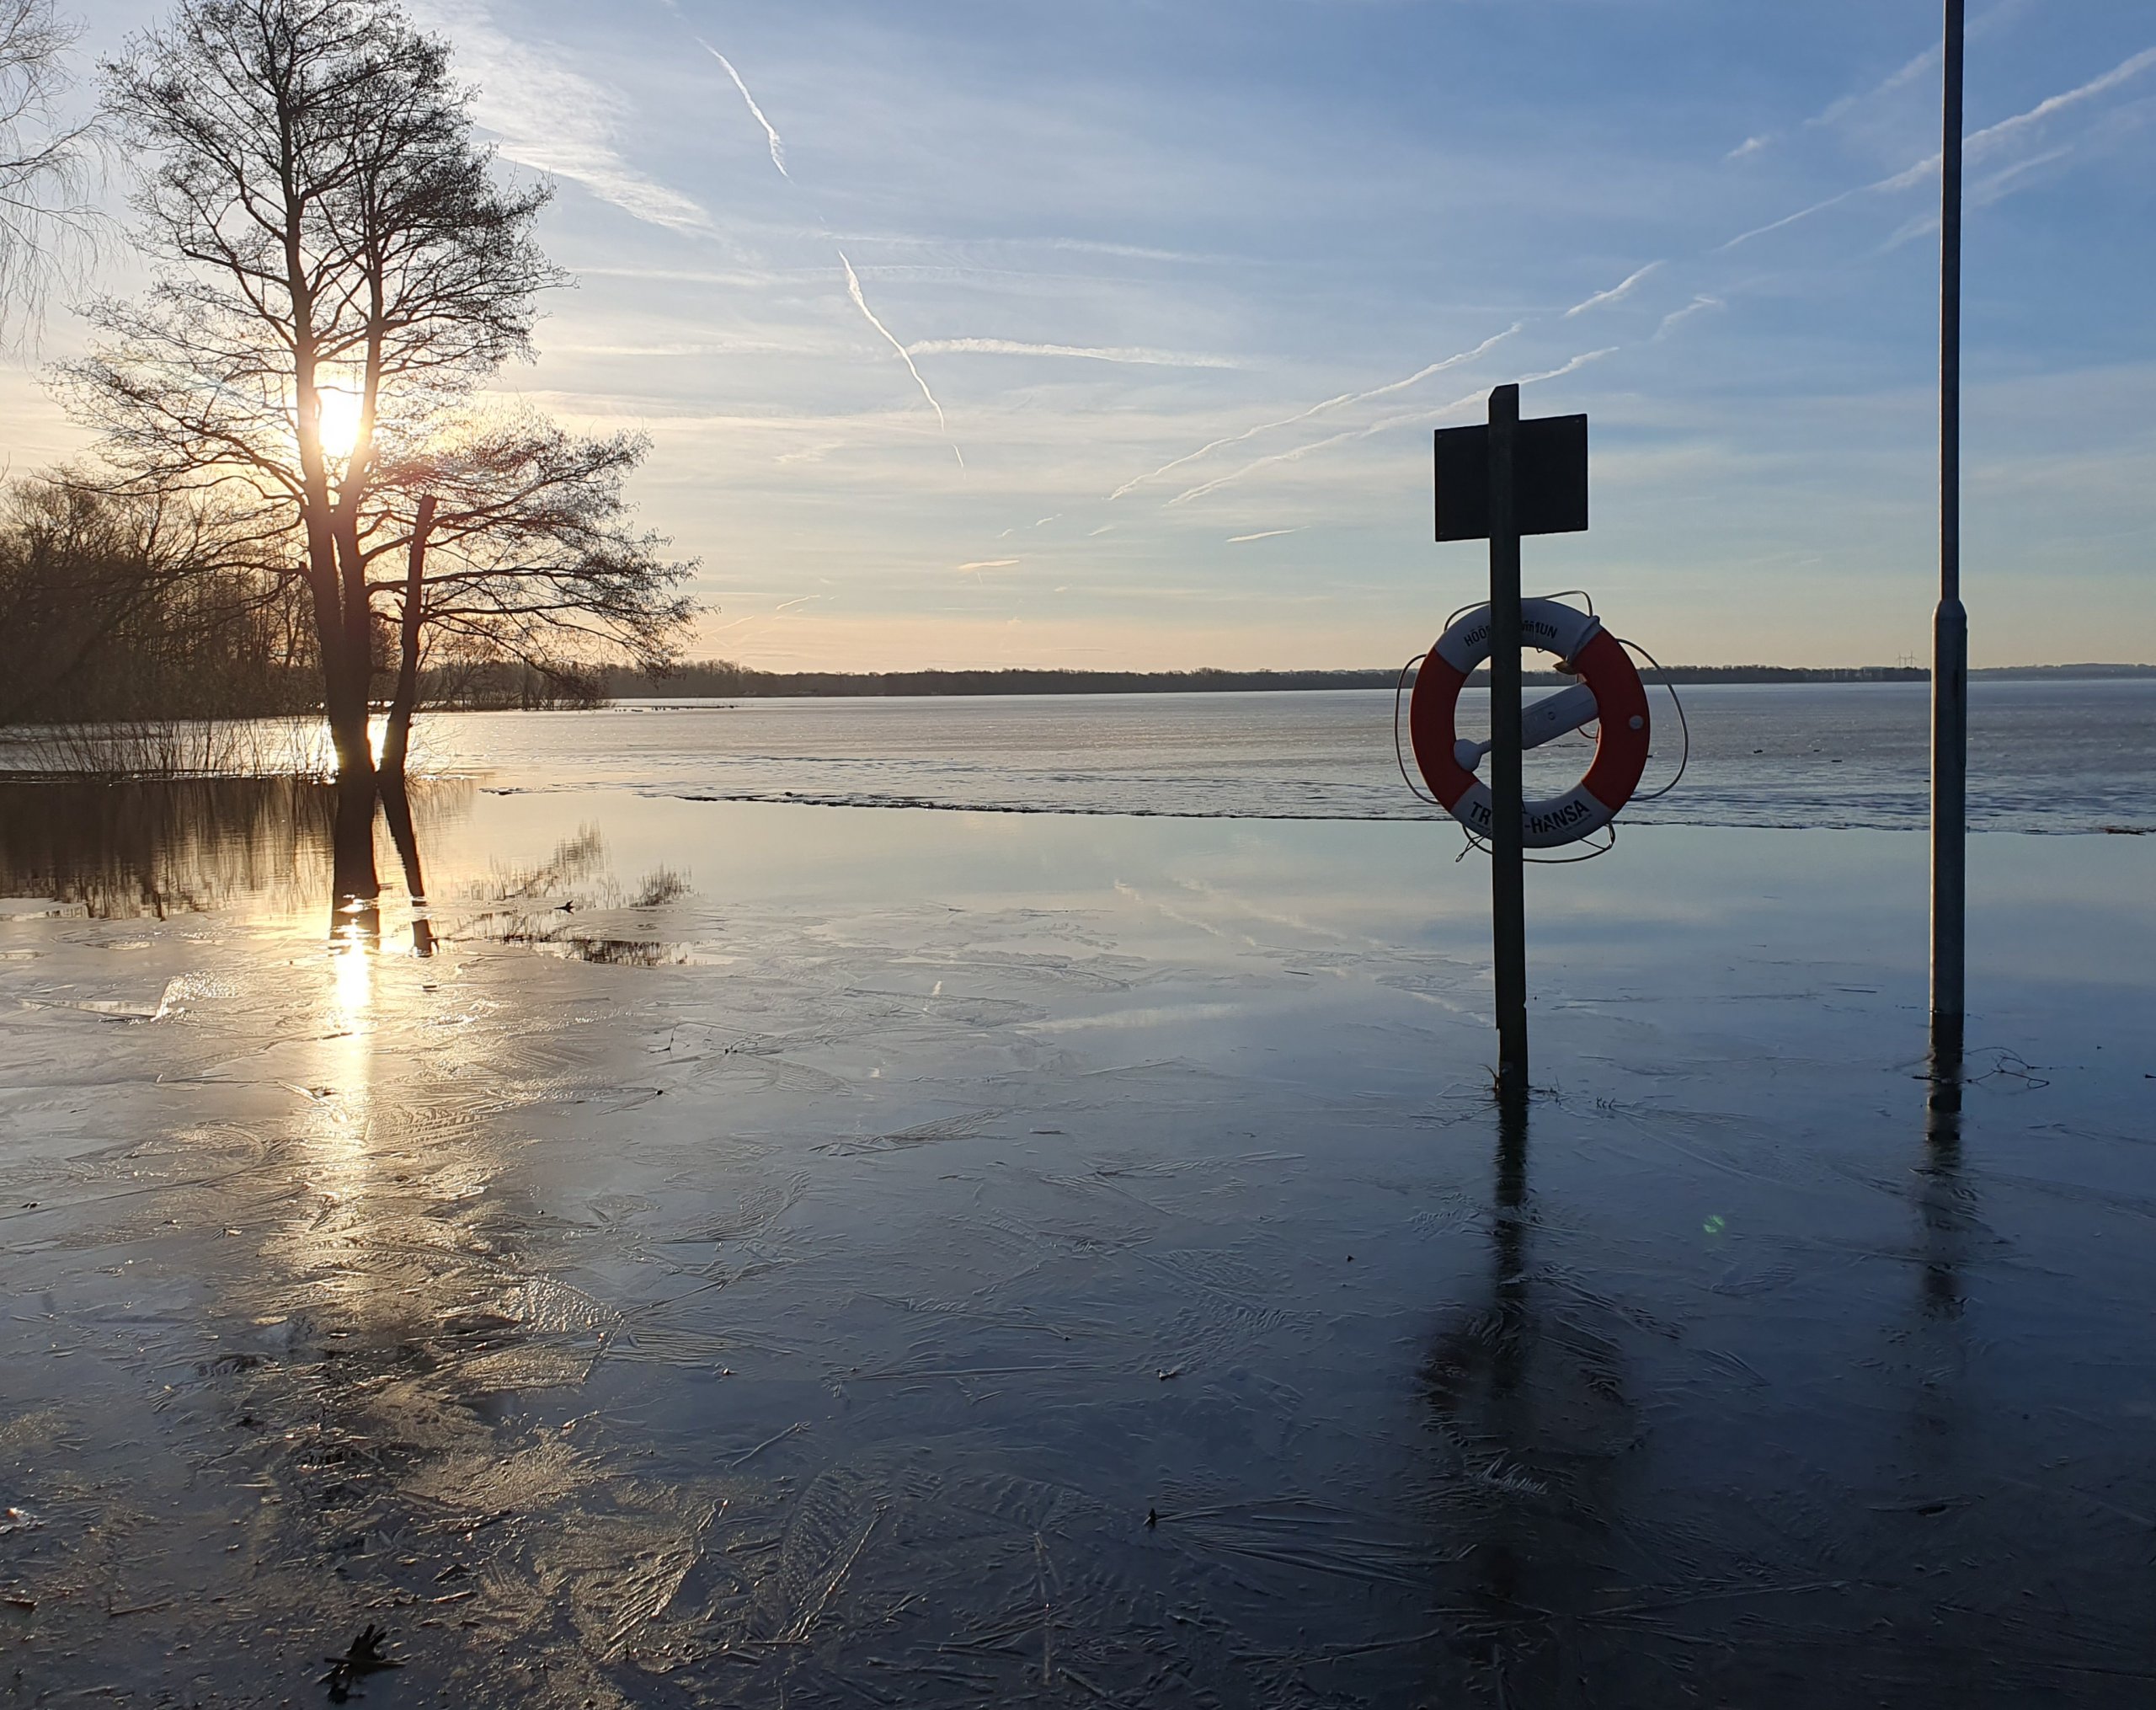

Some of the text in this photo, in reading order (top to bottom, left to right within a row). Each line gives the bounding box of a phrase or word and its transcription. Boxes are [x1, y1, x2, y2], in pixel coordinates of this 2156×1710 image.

[1464, 620, 1558, 647] HÖÖ MMUN
[1470, 799, 1591, 834] TR-HANSA
